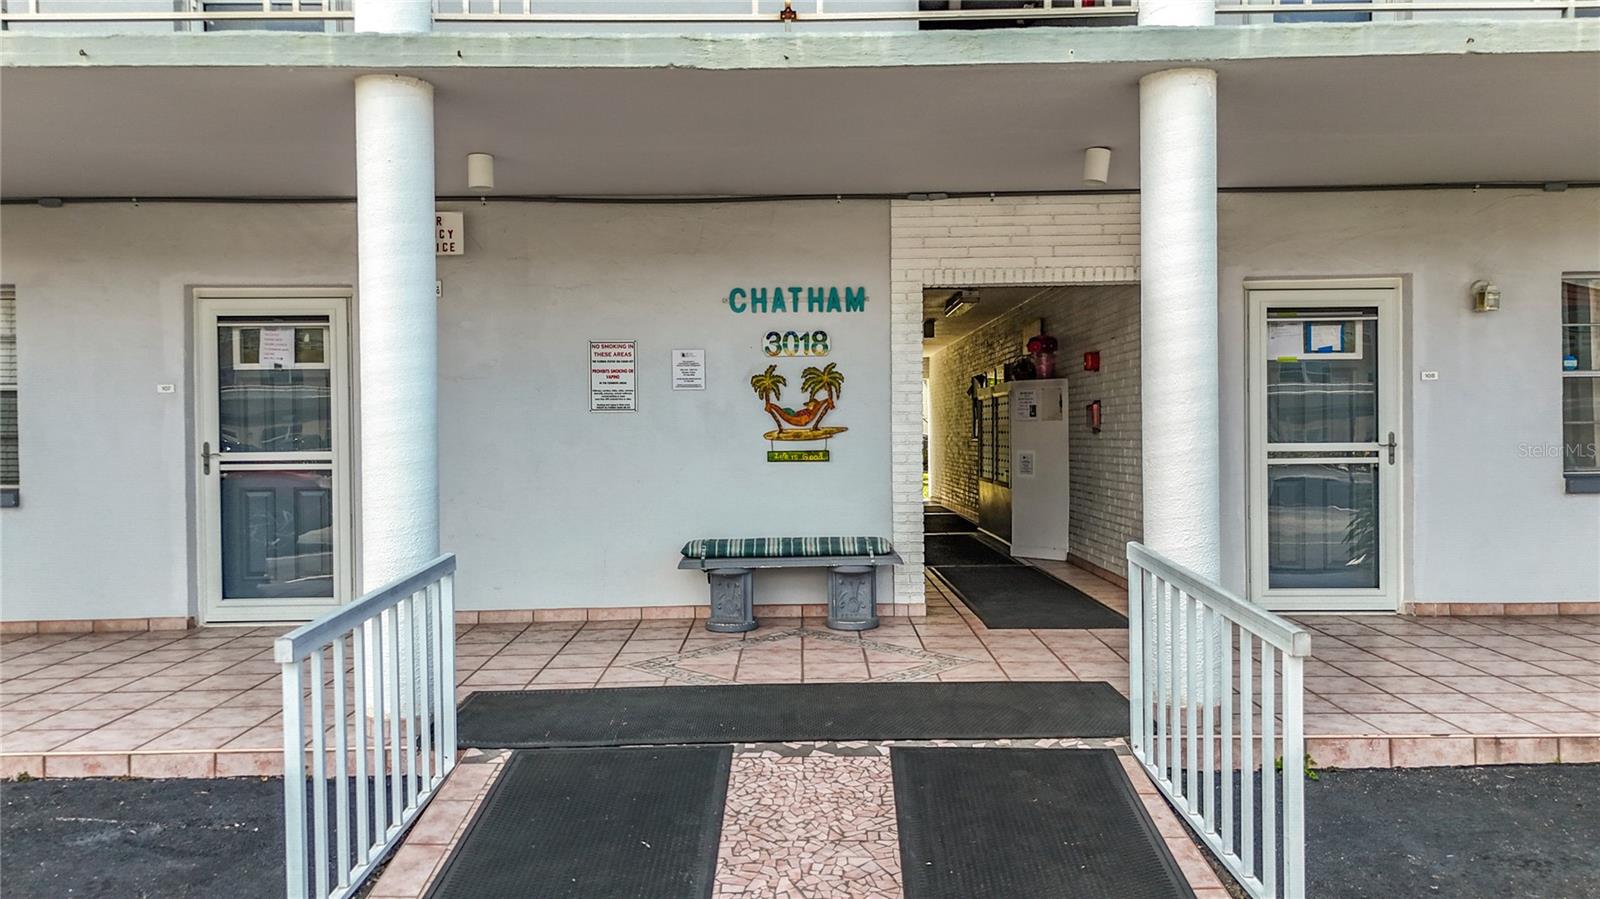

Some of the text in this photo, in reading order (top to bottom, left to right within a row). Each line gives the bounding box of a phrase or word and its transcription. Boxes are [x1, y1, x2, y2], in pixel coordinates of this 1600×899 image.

[436, 242, 455, 252] ICE
[729, 286, 865, 313] CHATHAM
[764, 330, 829, 357] 3018
